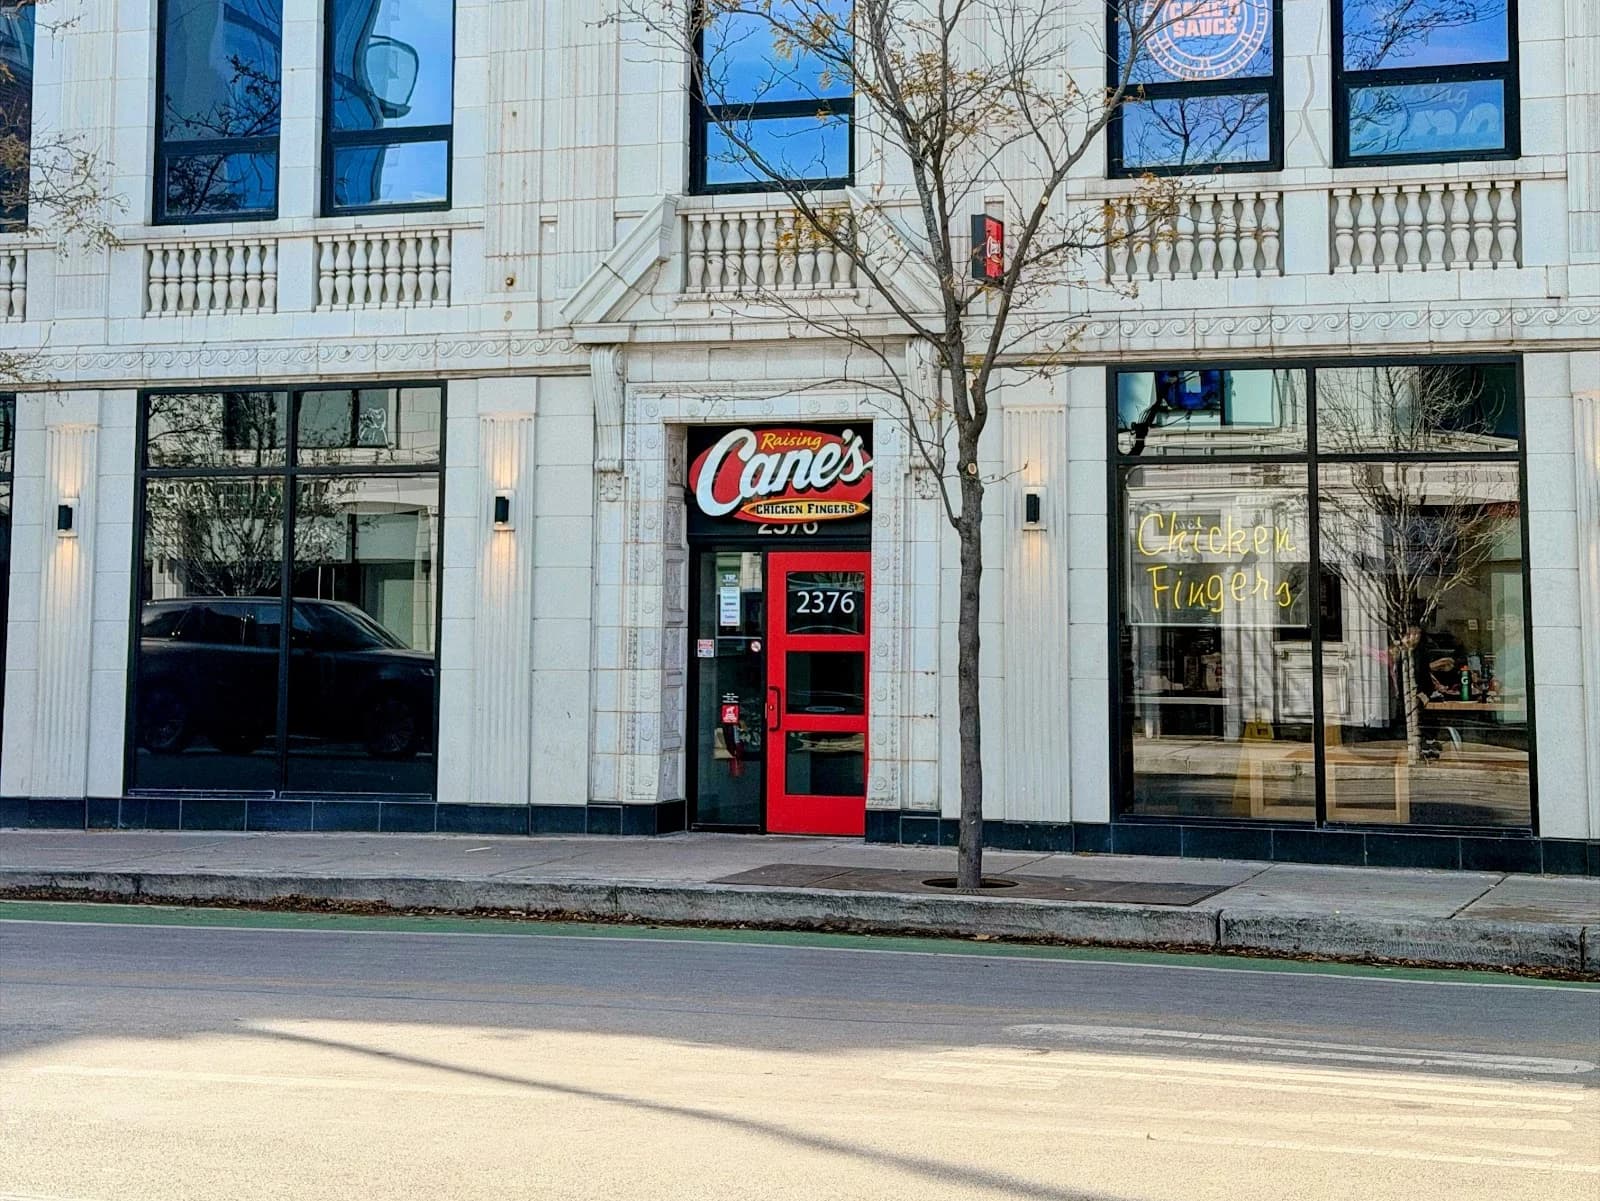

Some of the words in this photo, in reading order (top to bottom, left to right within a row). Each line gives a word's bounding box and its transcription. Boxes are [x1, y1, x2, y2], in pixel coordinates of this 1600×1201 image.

[1173, 17, 1237, 37] SAUCE
[760, 432, 823, 450] Raising
[696, 428, 873, 517] Cane's
[756, 504, 803, 515] CHICKEN
[807, 503, 855, 514] FINGERS
[1138, 511, 1297, 559] Chicken
[1146, 565, 1292, 613] Fingers
[796, 591, 855, 614] 2376
[1461, 676, 1469, 685] G
